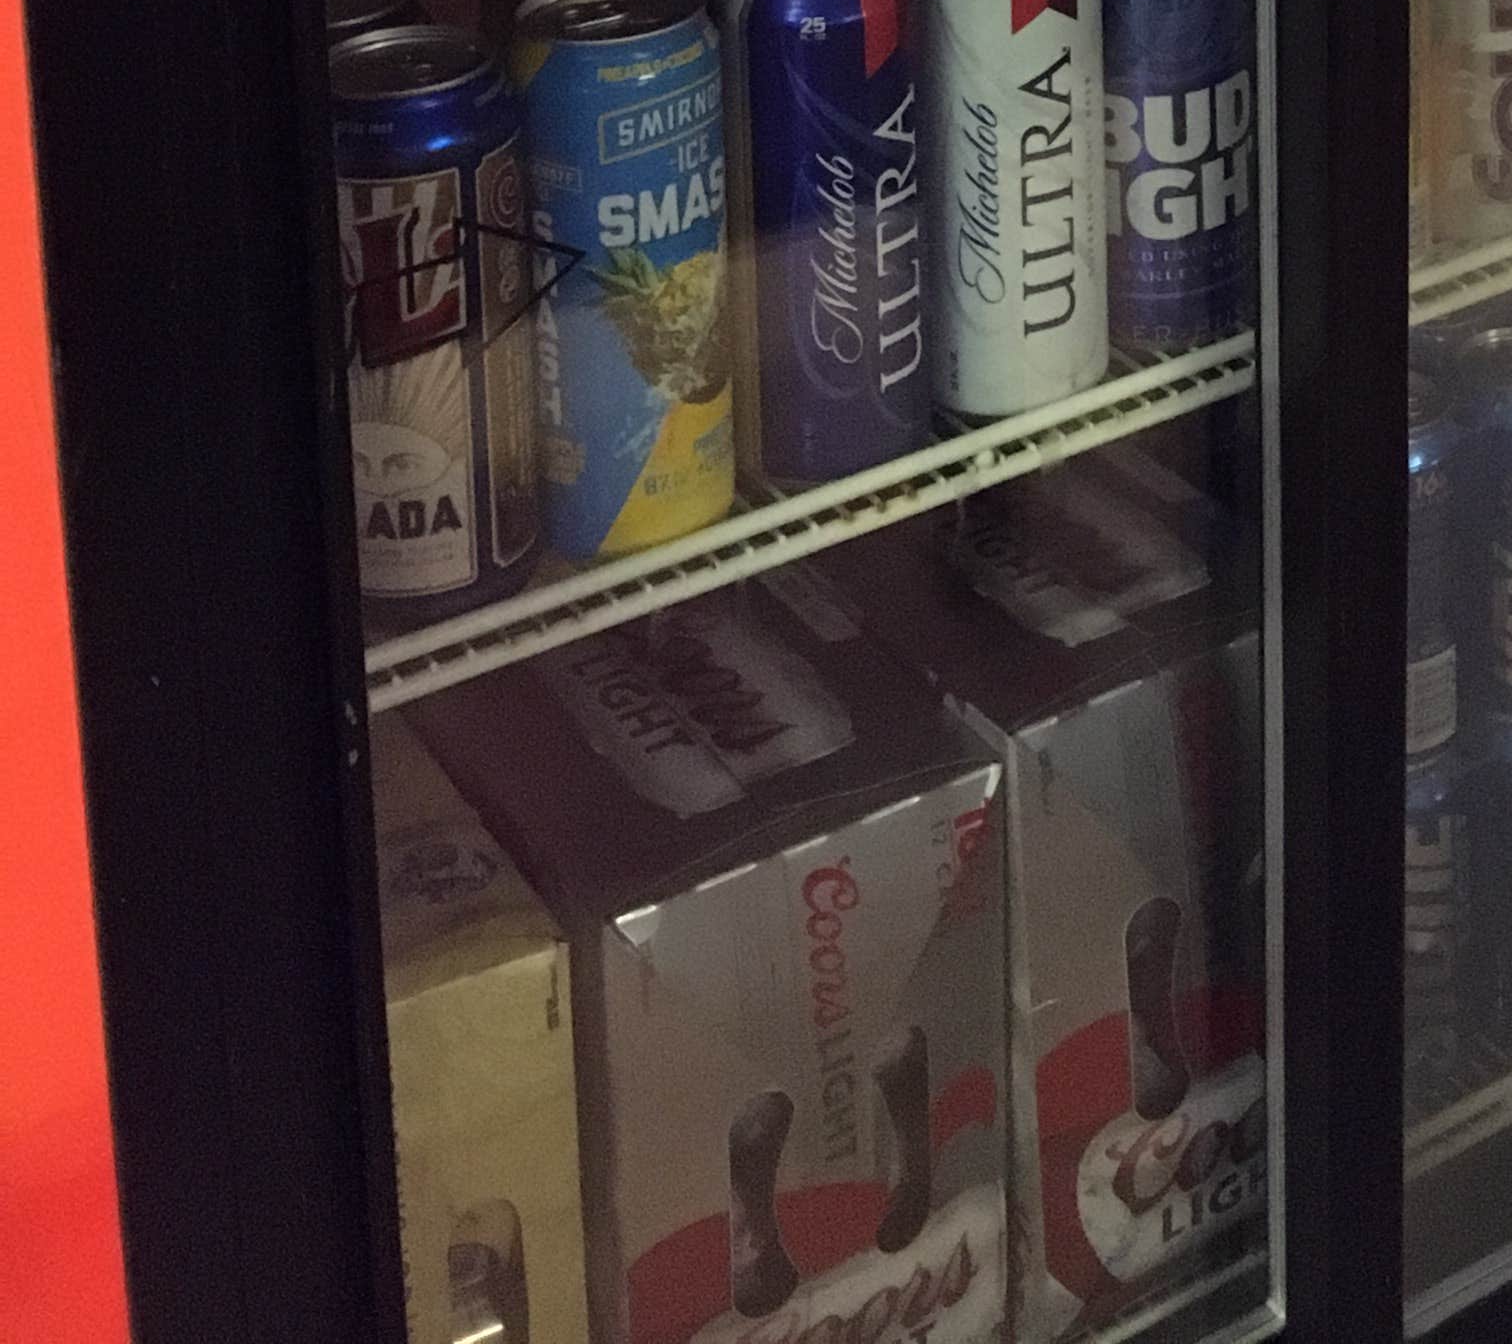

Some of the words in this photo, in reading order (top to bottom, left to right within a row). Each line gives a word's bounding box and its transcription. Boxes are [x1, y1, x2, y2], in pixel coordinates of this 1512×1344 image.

[800, 17, 827, 33] 25
[677, 133, 709, 175] ICE
[1103, 68, 1252, 165] BUD
[810, 153, 864, 365] Michelob
[873, 82, 922, 394] ULTRA
[957, 100, 1006, 306] Michelob
[1017, 49, 1079, 339] ULTRA
[1107, 135, 1252, 241] IGH
[801, 855, 860, 1030] Coors
[814, 1028, 860, 1164] LIGHT
